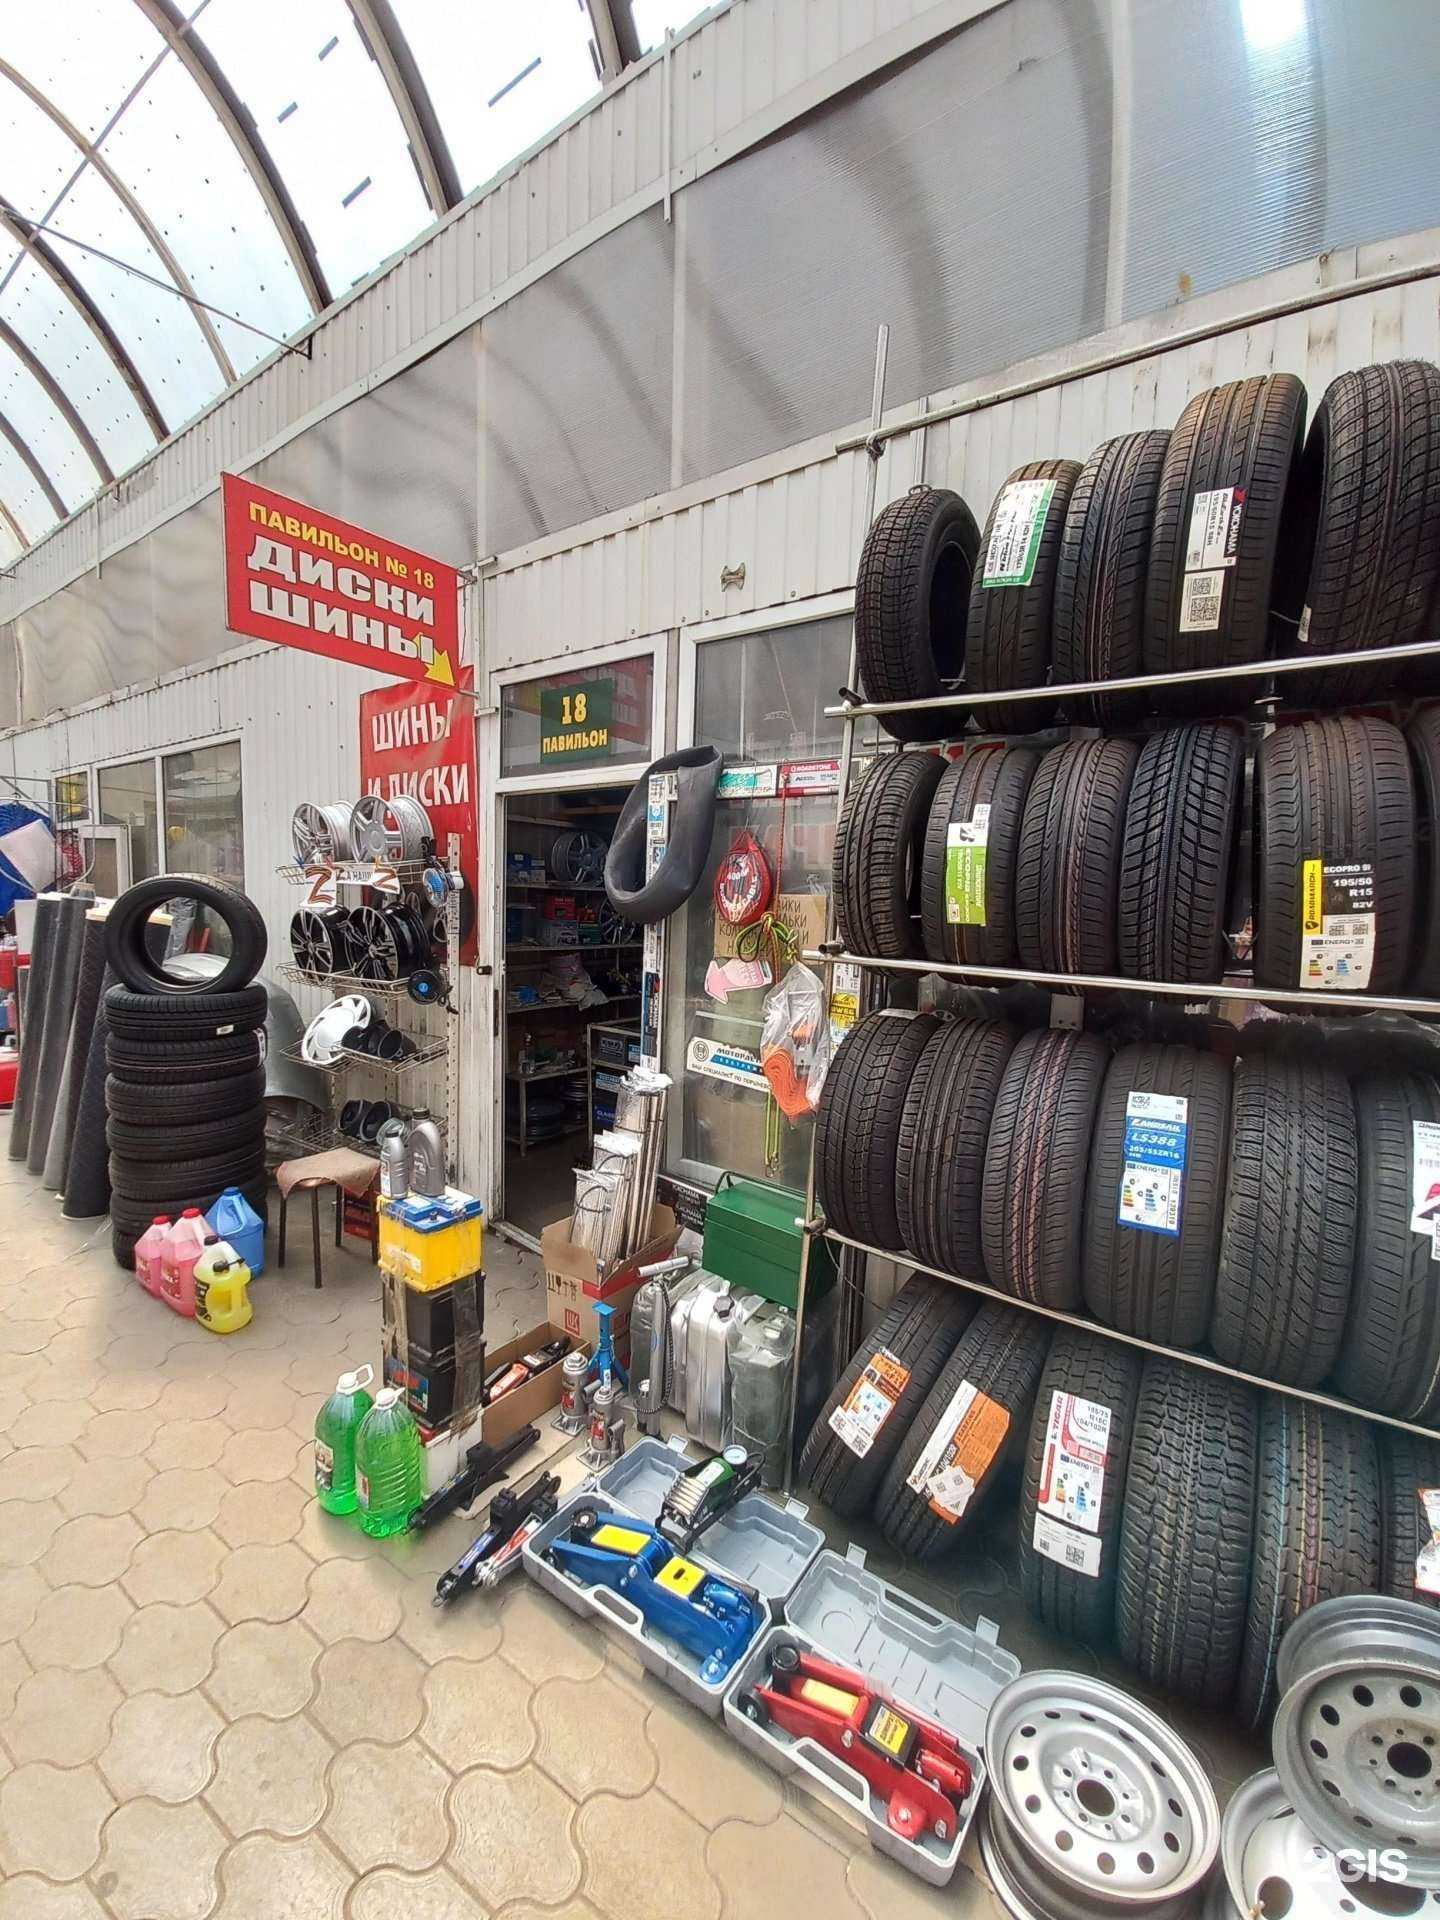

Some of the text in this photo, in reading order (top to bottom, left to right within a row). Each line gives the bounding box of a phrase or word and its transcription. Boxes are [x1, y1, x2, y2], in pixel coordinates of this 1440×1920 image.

[1227, 503, 1241, 553] YOKOHAMA
[249, 500, 435, 589] ПАВИЛЬОН № 18
[248, 535, 434, 626] ДИСКИ
[250, 580, 434, 664] ШИНЫ
[562, 693, 587, 725] 18
[372, 699, 454, 752] ШИНЫ
[542, 729, 608, 754] ПАВИЛЬОН
[1323, 864, 1360, 873] ECOPRO
[1332, 877, 1373, 887] 195/50
[1349, 888, 1373, 897] R15
[1131, 1133, 1177, 1147] LS388
[1053, 1396, 1063, 1429] TIGAR
